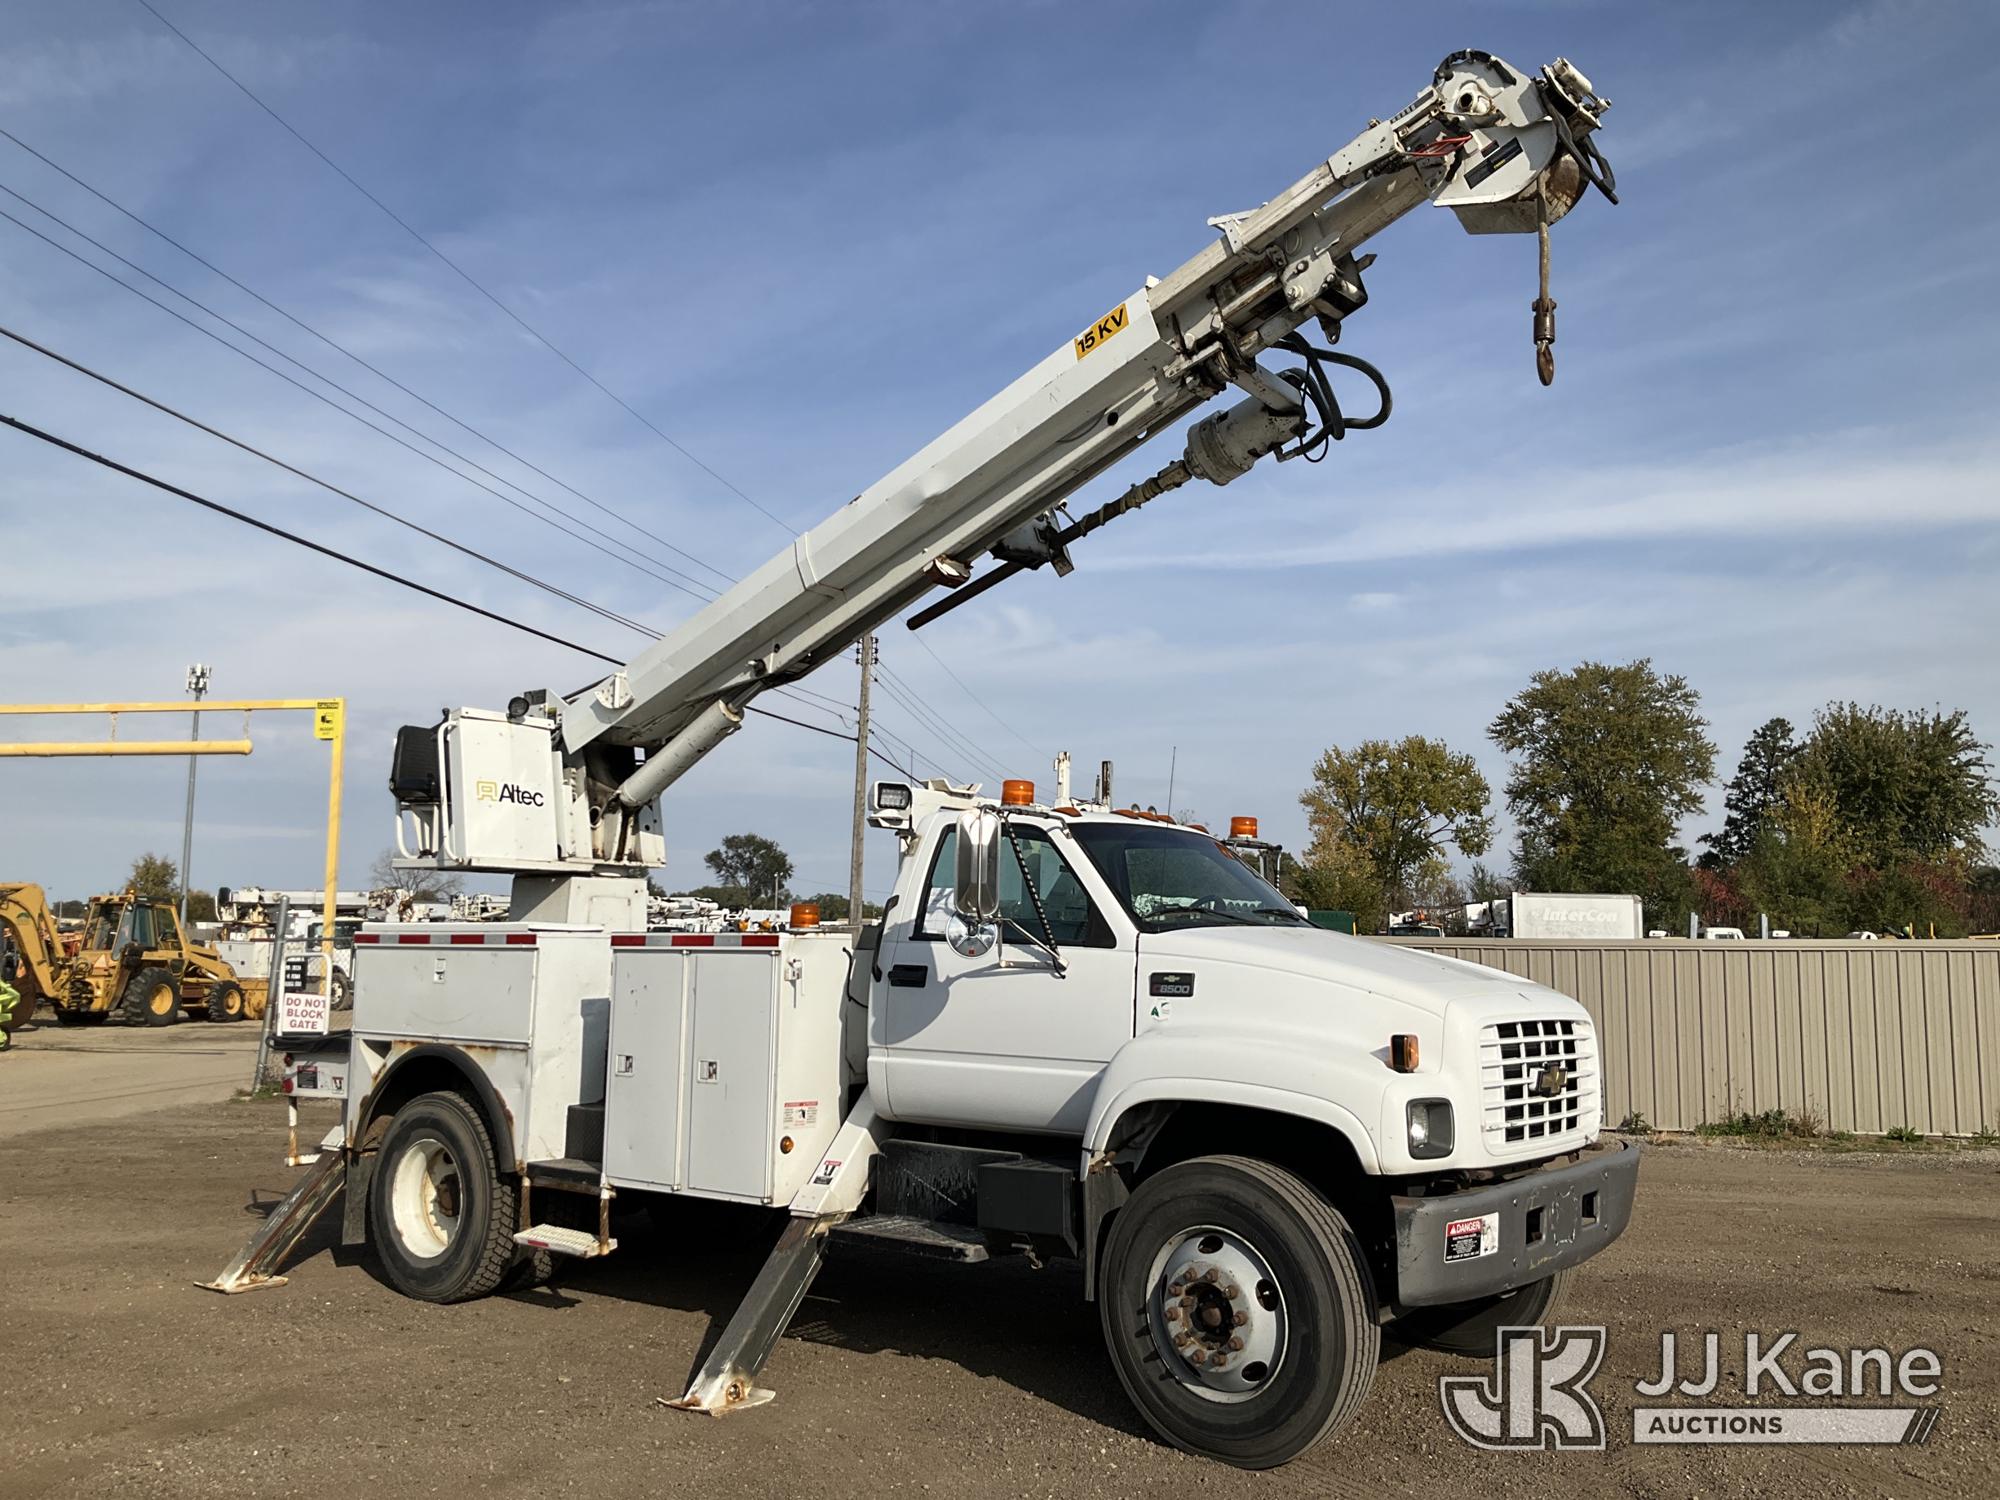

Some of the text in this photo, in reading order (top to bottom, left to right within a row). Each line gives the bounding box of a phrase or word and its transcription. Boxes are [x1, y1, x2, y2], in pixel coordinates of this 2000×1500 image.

[1077, 308, 1124, 353] 15 KV
[498, 783, 544, 807] Altec
[286, 997, 301, 1007] DO
[286, 1008, 324, 1020] BLOCK
[289, 1019, 318, 1030] GATE
[1456, 1220, 1480, 1234] DANGER
